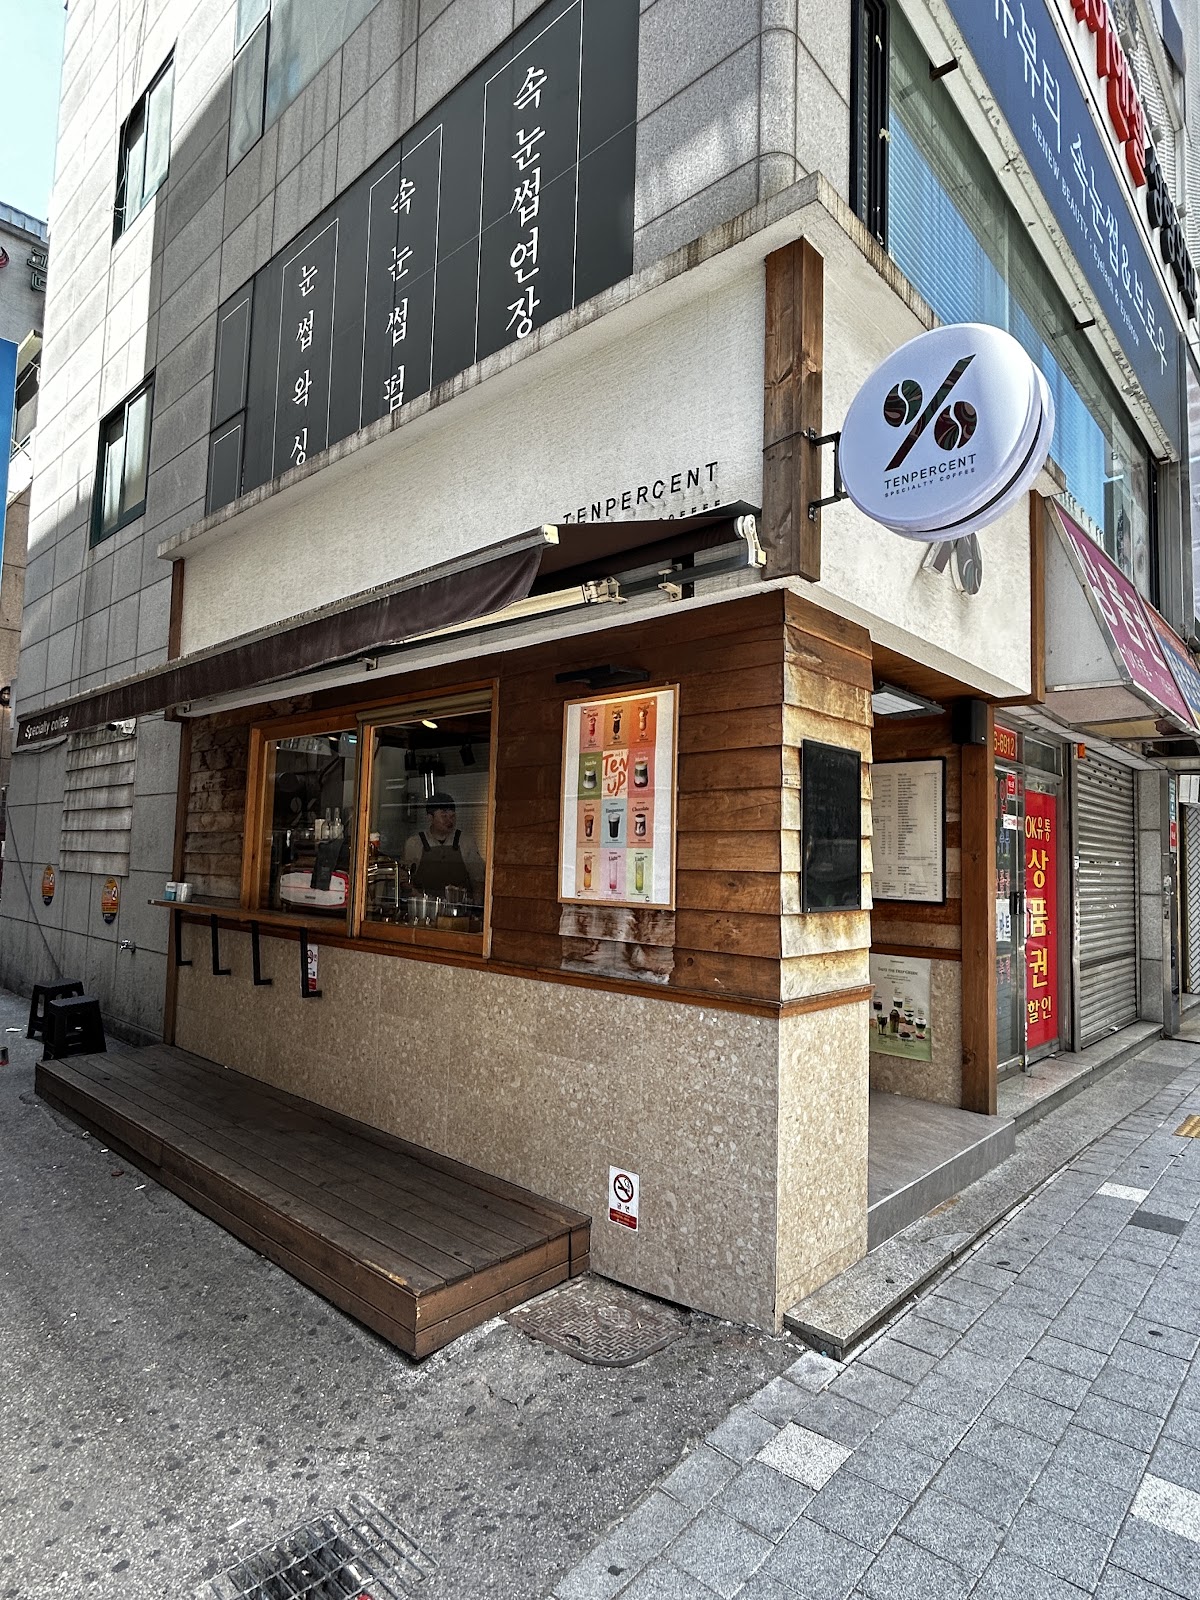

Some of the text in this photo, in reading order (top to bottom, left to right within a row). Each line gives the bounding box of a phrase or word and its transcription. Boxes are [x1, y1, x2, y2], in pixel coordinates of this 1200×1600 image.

[505, 66, 548, 338] 속눈썹연장
[1031, 113, 1061, 181] RENEW
[1061, 176, 1089, 240] BEAUTY
[290, 265, 318, 466] 눈썹왁싱
[562, 461, 718, 525] TENPERCENT
[884, 467, 976, 498] SPECIALTY COFFEE
[885, 453, 977, 490] TENPERCENT
[1068, 532, 1169, 672] 상품권
[25, 715, 69, 740] Specialty coffee
[1025, 815, 1051, 843] OK유통
[1027, 848, 1050, 989] 상품권
[1027, 995, 1052, 1024] 할인
